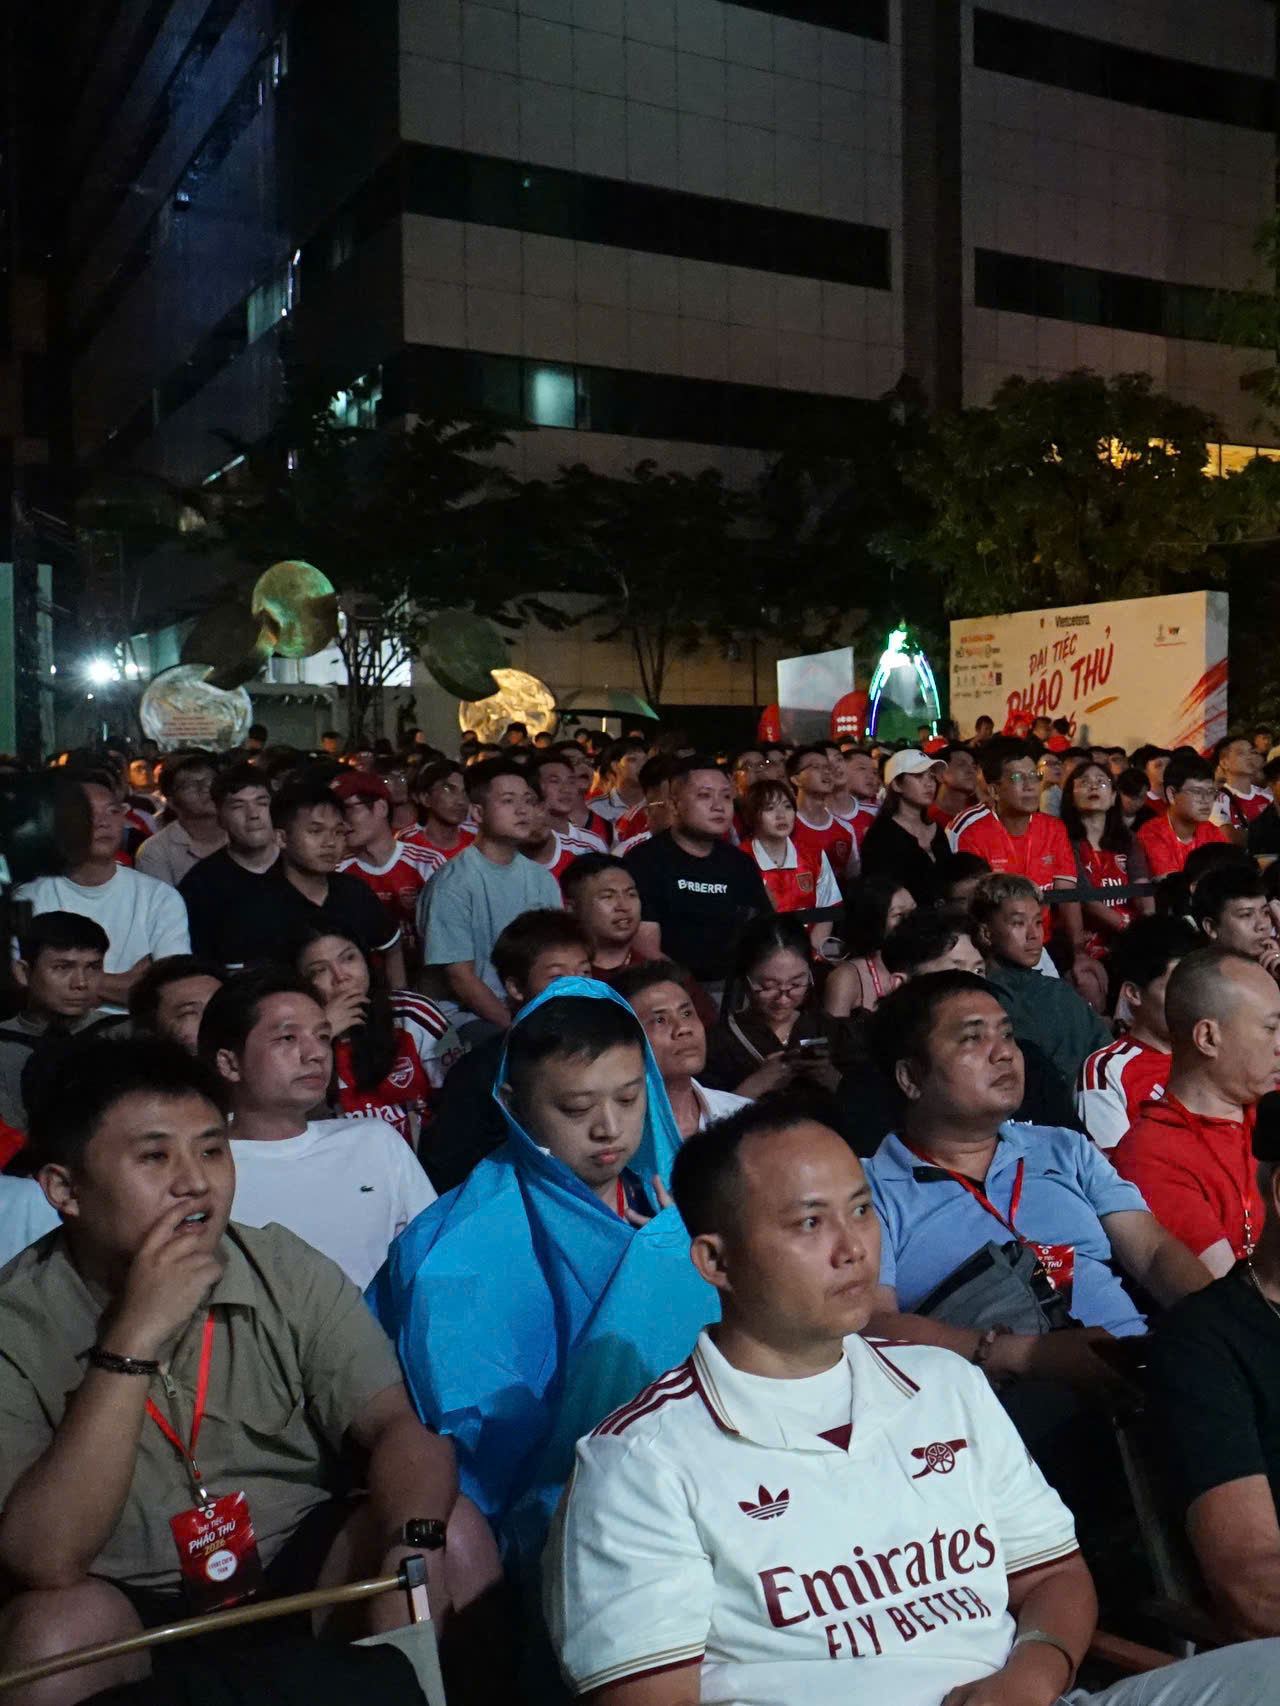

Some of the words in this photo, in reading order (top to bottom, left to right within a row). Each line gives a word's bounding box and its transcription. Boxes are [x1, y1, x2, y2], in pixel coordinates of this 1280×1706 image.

[757, 1523, 996, 1628] Emirates
[824, 1613, 883, 1659] FLY
[885, 1585, 992, 1642] BETTER
